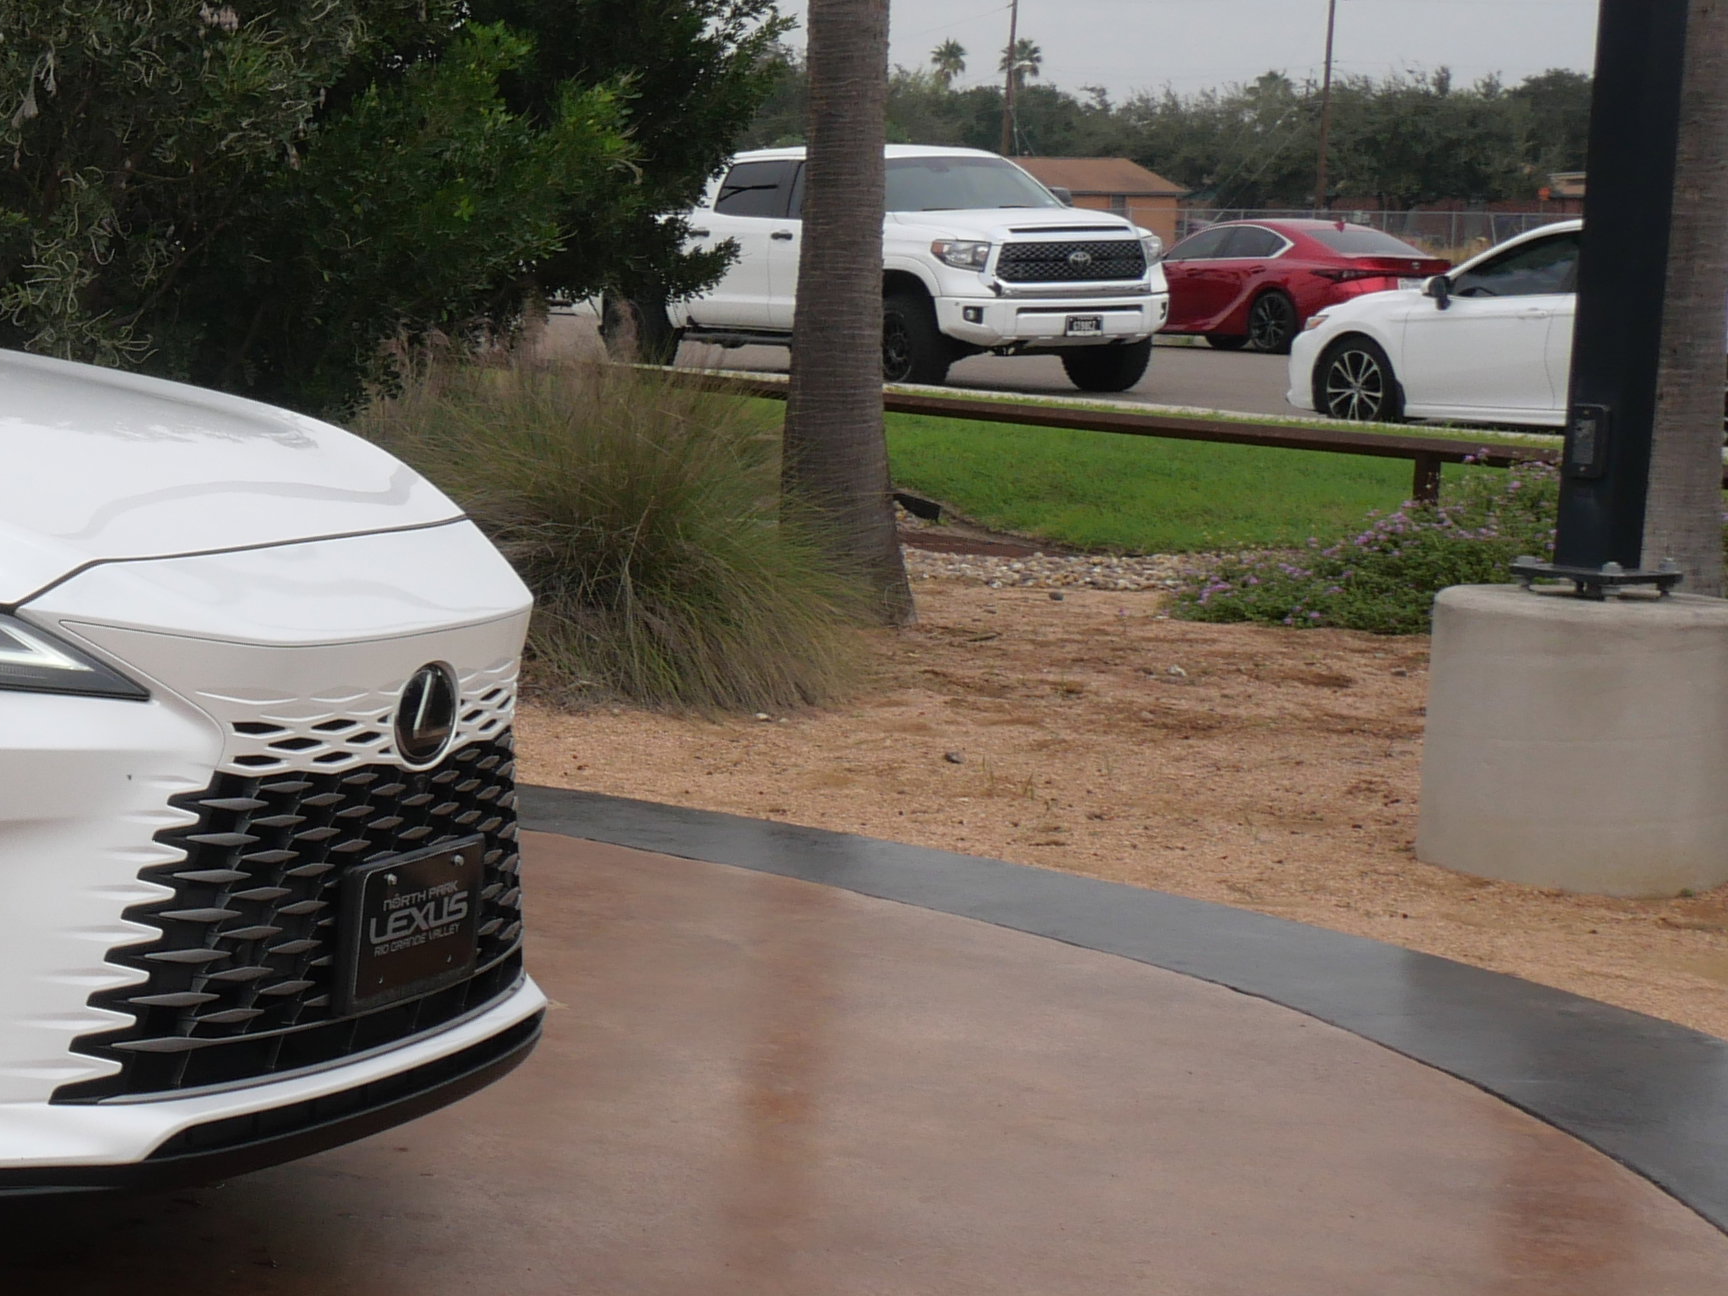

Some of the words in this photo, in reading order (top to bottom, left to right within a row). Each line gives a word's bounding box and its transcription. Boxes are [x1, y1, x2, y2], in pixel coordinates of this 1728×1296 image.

[383, 890, 426, 911] NORTH
[428, 880, 458, 899] PARK
[369, 891, 468, 944] LEXUS
[374, 944, 389, 957] RIO
[390, 933, 426, 952] GRANDE
[428, 923, 460, 940] VALLEY
